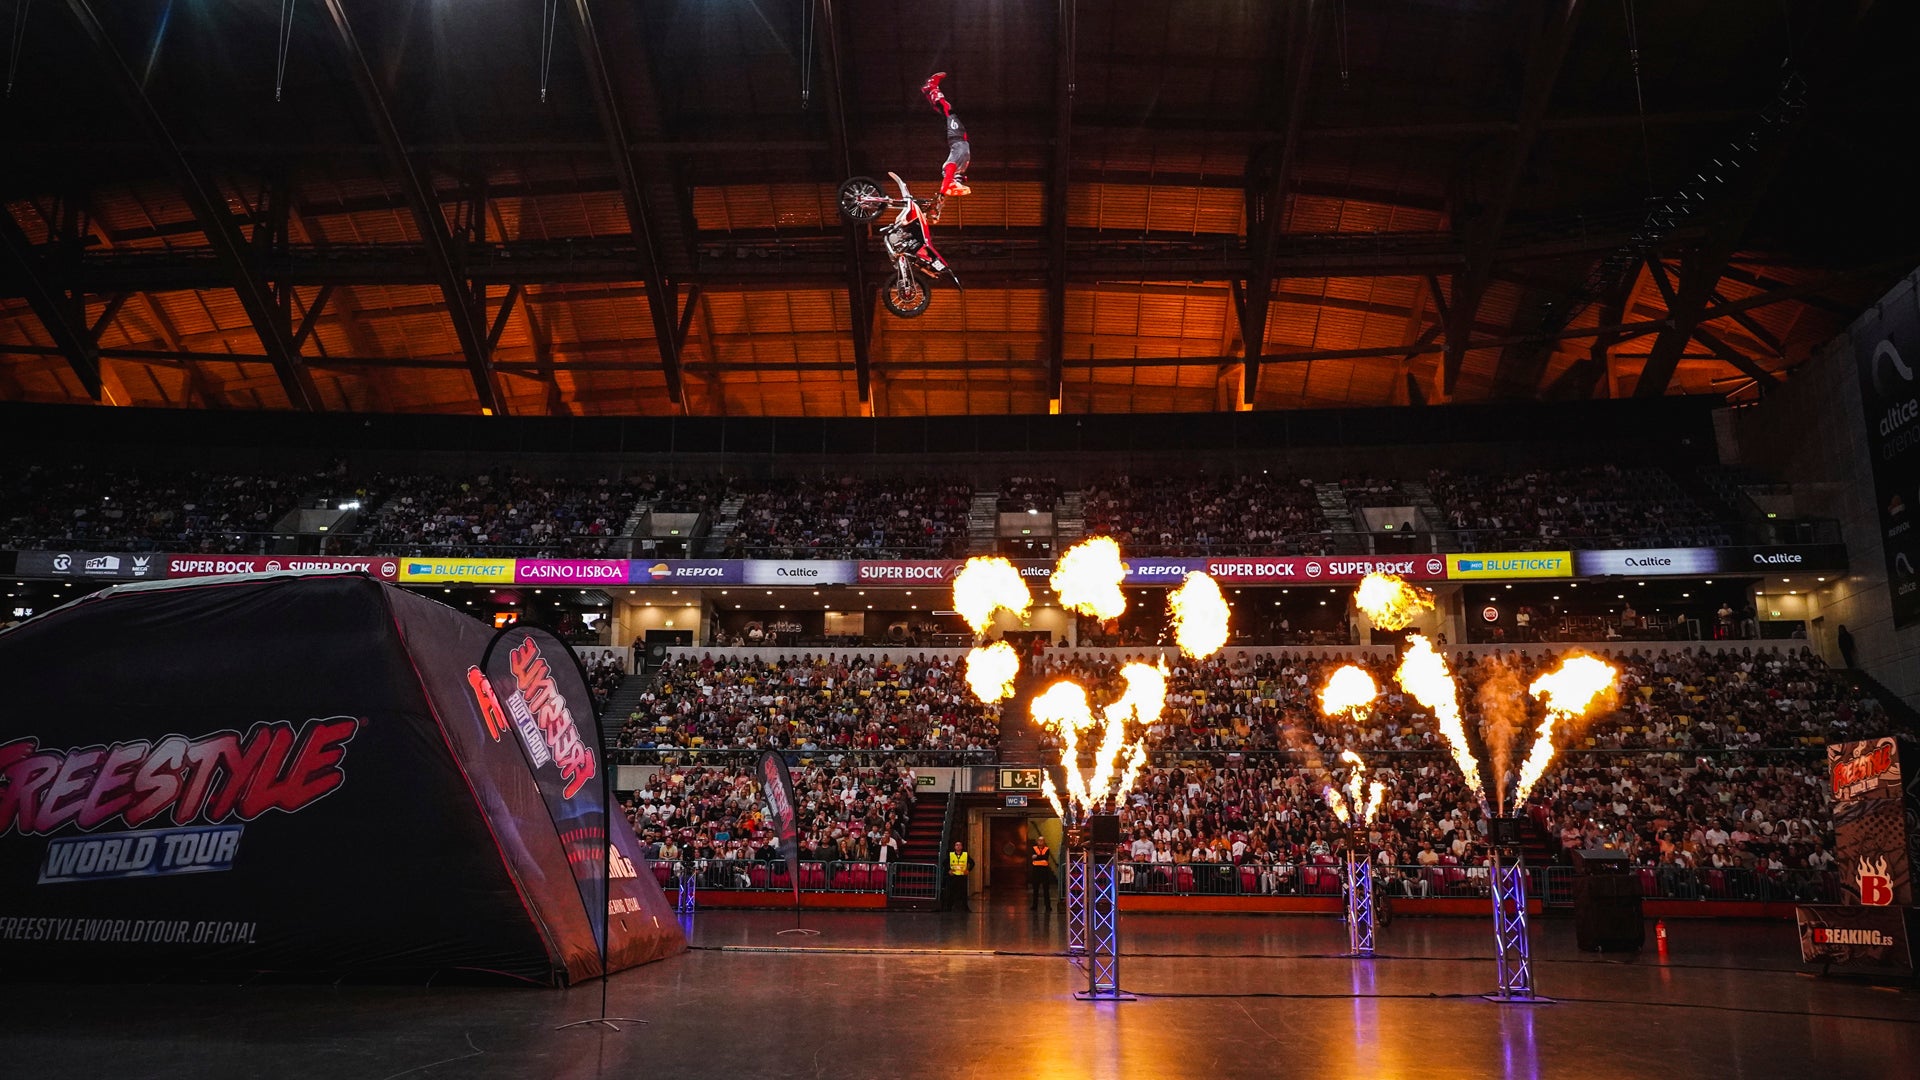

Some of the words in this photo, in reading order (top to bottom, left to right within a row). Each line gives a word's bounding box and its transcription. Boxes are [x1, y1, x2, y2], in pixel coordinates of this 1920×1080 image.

[1879, 398, 1919, 437] altice
[85, 557, 108, 568] RFM
[1486, 559, 1562, 571] BLUETICKET
[1639, 556, 1671, 567] altice
[1768, 552, 1802, 565] altice
[170, 560, 213, 573] SUPER
[216, 561, 255, 573] BOCK
[435, 565, 505, 576] BLUETICKET
[520, 565, 574, 578] CASINO
[576, 565, 623, 578] LISBOA
[676, 567, 724, 576] REPSOL
[789, 567, 818, 577] altice
[860, 566, 903, 579] SUPER
[905, 566, 943, 579] BOCK
[1020, 565, 1050, 577] altice
[1138, 566, 1188, 575] REPSOL
[1210, 563, 1253, 576] SUPER
[1255, 563, 1295, 576] BOCK
[1329, 562, 1373, 575] SUPER
[1376, 561, 1415, 574] BOCK
[0, 716, 358, 836] REESTYLE
[47, 836, 155, 876] WORLD
[161, 830, 240, 867] TOUR
[1860, 875, 1893, 906] B
[1813, 927, 1894, 946] BREAKING.ES
